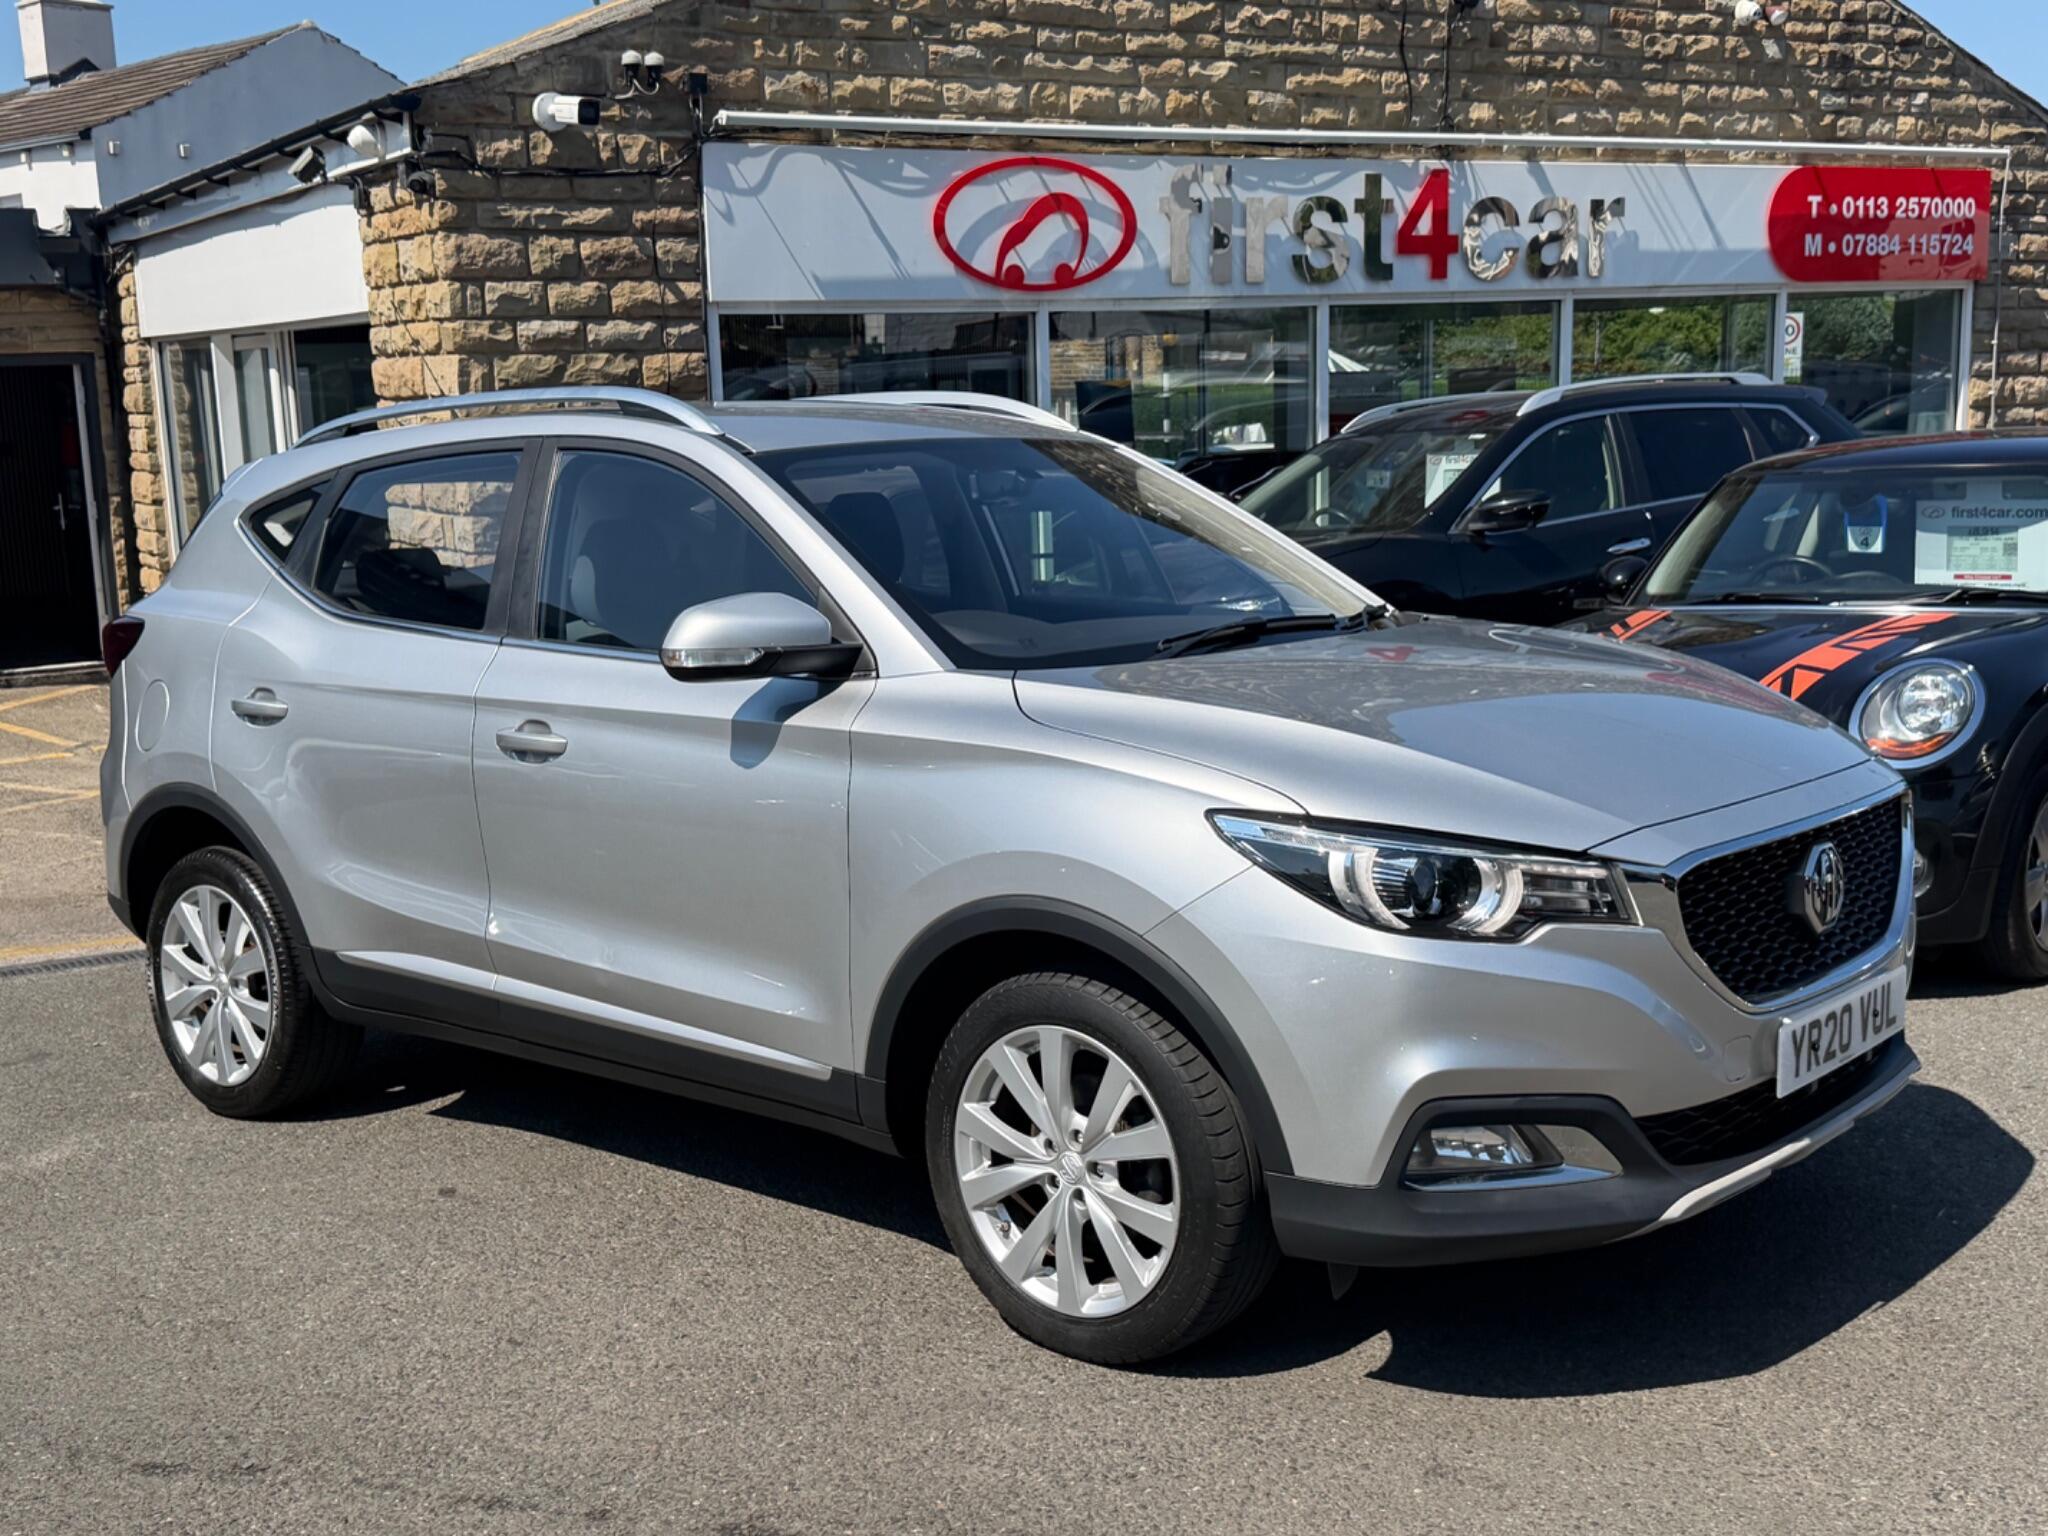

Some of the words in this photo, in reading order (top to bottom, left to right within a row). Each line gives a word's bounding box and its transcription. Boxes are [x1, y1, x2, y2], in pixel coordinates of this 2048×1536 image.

[1807, 195, 1823, 218] T
[1842, 196, 1889, 219] 0113
[1895, 197, 1976, 219] 2570000
[1158, 164, 1626, 284] first4car
[1804, 233, 1823, 257] M
[1842, 233, 1899, 257] 07884
[1908, 234, 1974, 257] 115724
[1951, 506, 2048, 519] first4car.com
[1791, 1002, 1853, 1078] YR20
[1860, 981, 1897, 1042] VUL
